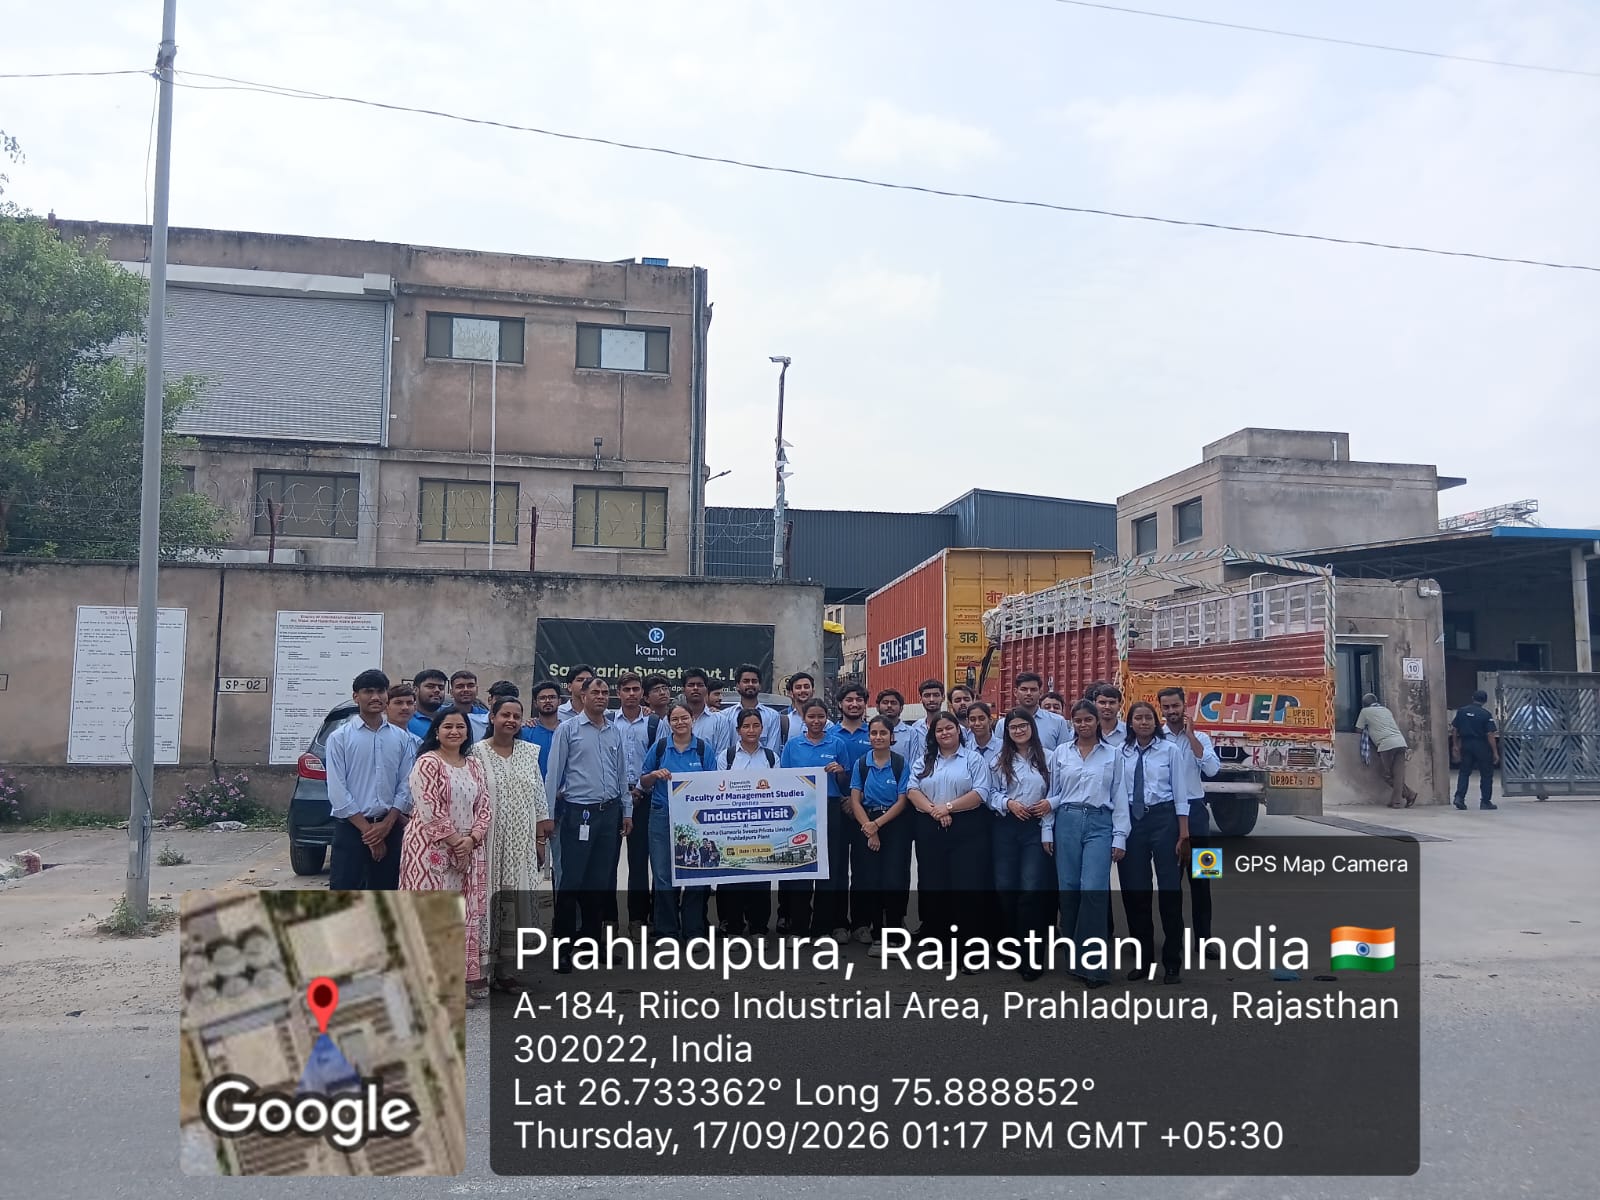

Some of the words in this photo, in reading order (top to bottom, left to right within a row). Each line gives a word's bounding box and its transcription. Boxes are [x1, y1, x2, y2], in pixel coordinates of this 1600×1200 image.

[959, 632, 978, 643] डाक
[635, 643, 676, 656] kanha
[549, 663, 630, 678] Saaria
[225, 680, 261, 690] SP-02
[685, 794, 715, 803] Faculty
[725, 790, 775, 801] Management
[775, 789, 804, 797] Studies
[703, 809, 761, 821] Industrial
[764, 808, 788, 818] visit
